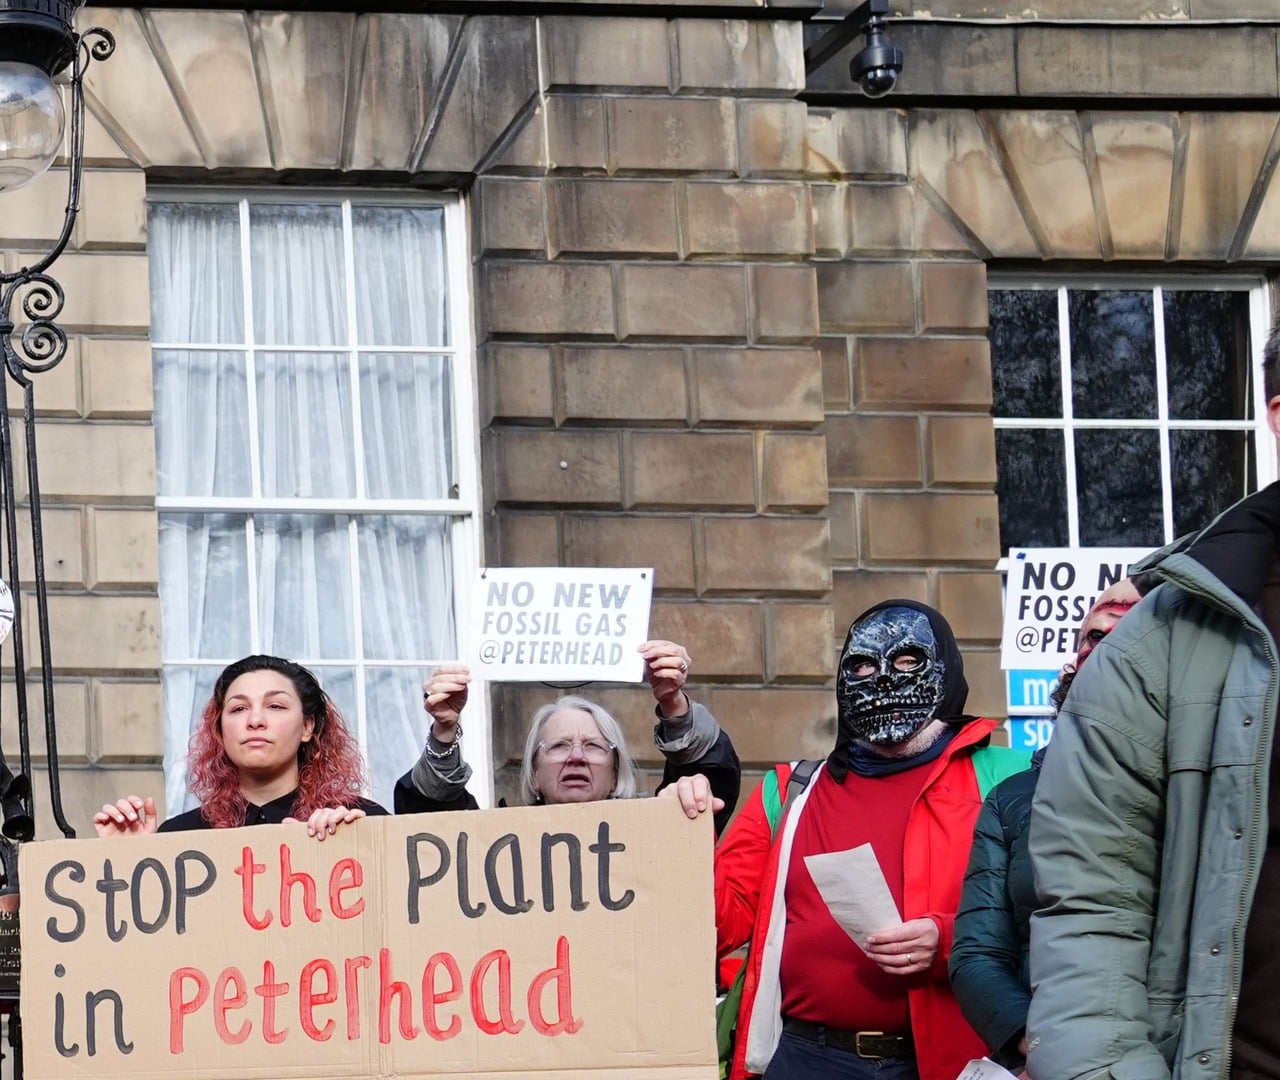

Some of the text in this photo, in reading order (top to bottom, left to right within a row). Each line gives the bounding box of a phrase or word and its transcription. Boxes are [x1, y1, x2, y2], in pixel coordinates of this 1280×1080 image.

[1022, 561, 1134, 592] NO N
[486, 581, 632, 609] NO NEW
[482, 611, 628, 637] FOSSIL GAS
[479, 639, 624, 666] @PETERHEAD
[234, 843, 366, 931] the
[406, 820, 636, 924] Plant
[53, 934, 586, 1058] in Peterhead
